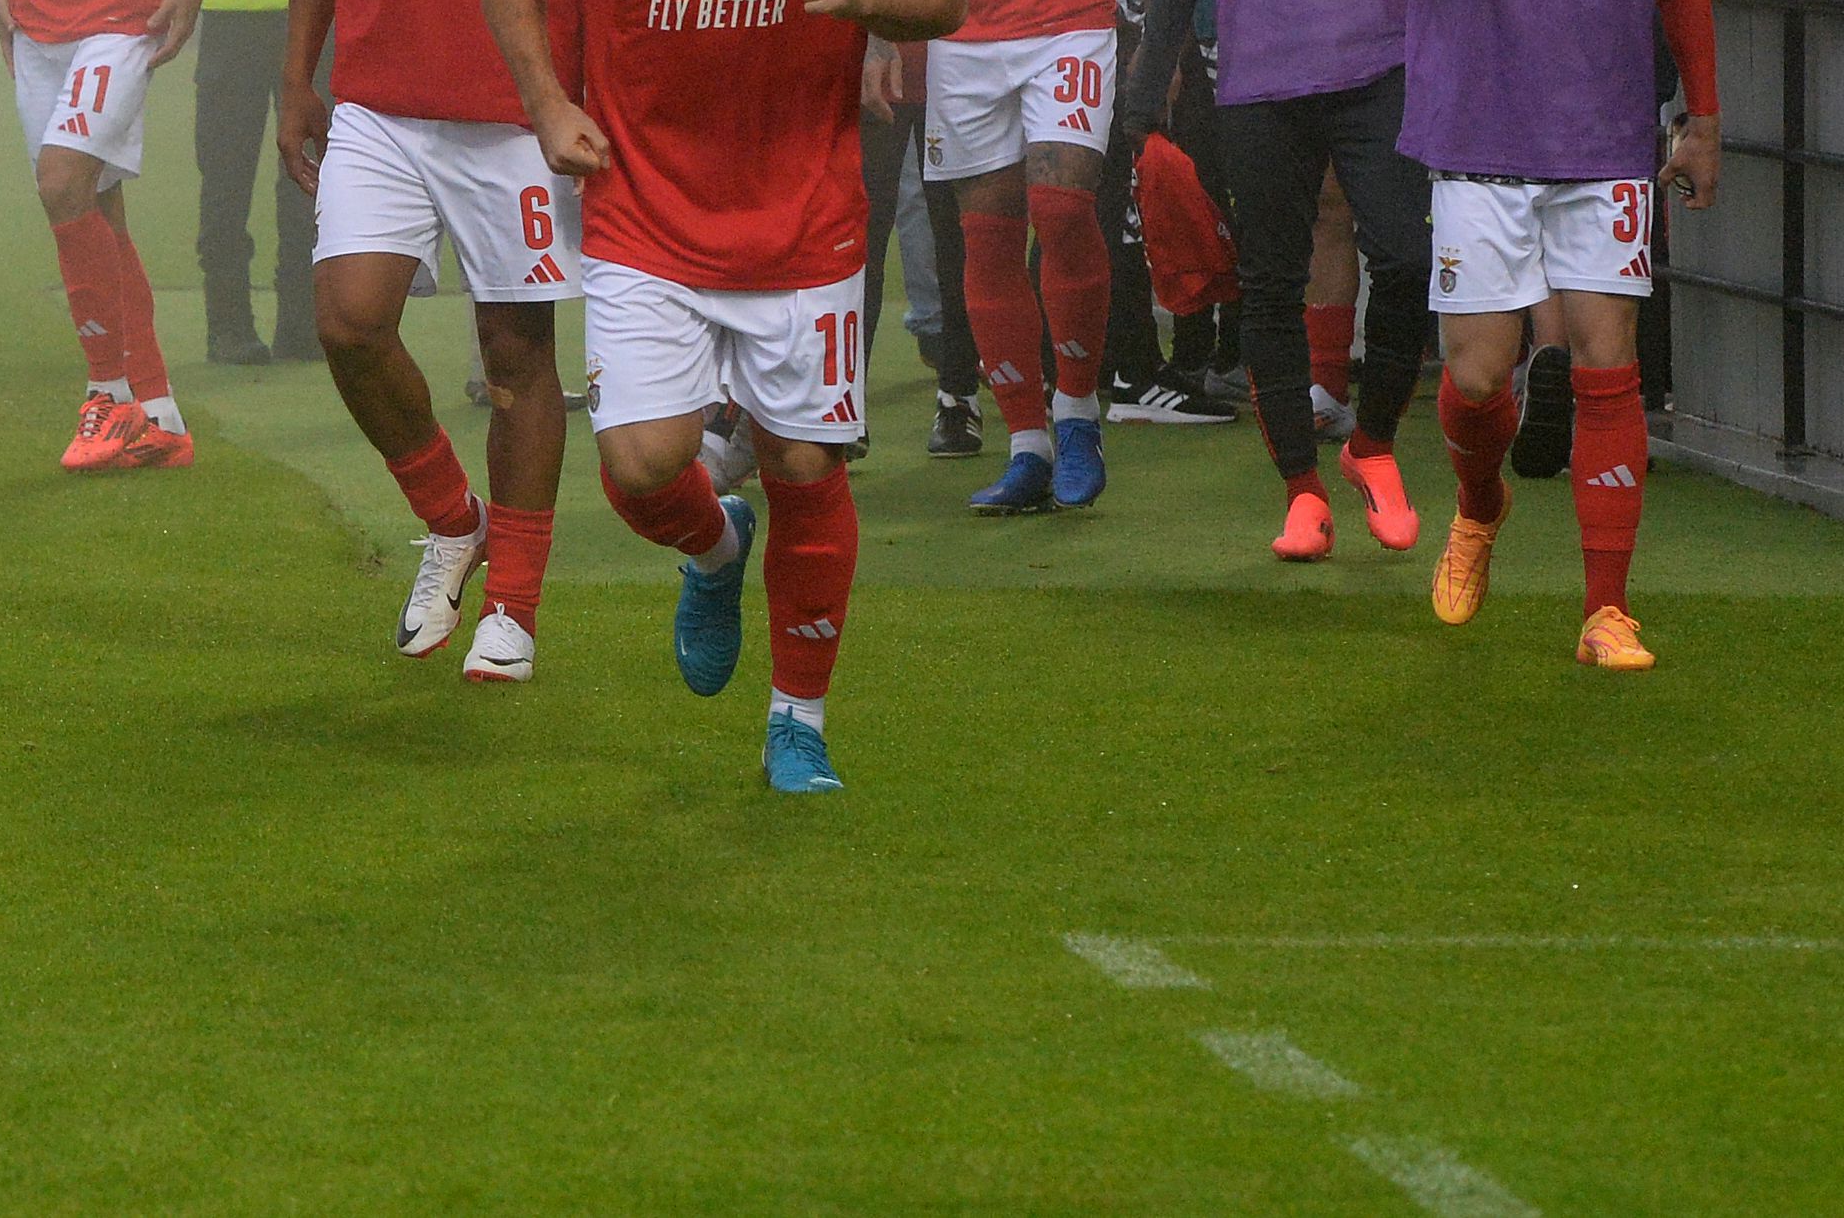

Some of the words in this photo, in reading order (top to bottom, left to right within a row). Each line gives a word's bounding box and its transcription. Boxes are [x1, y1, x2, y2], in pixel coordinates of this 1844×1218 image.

[67, 65, 113, 114] 11
[1054, 55, 1103, 108] 30
[519, 184, 555, 251] 6
[814, 309, 858, 386] 10
